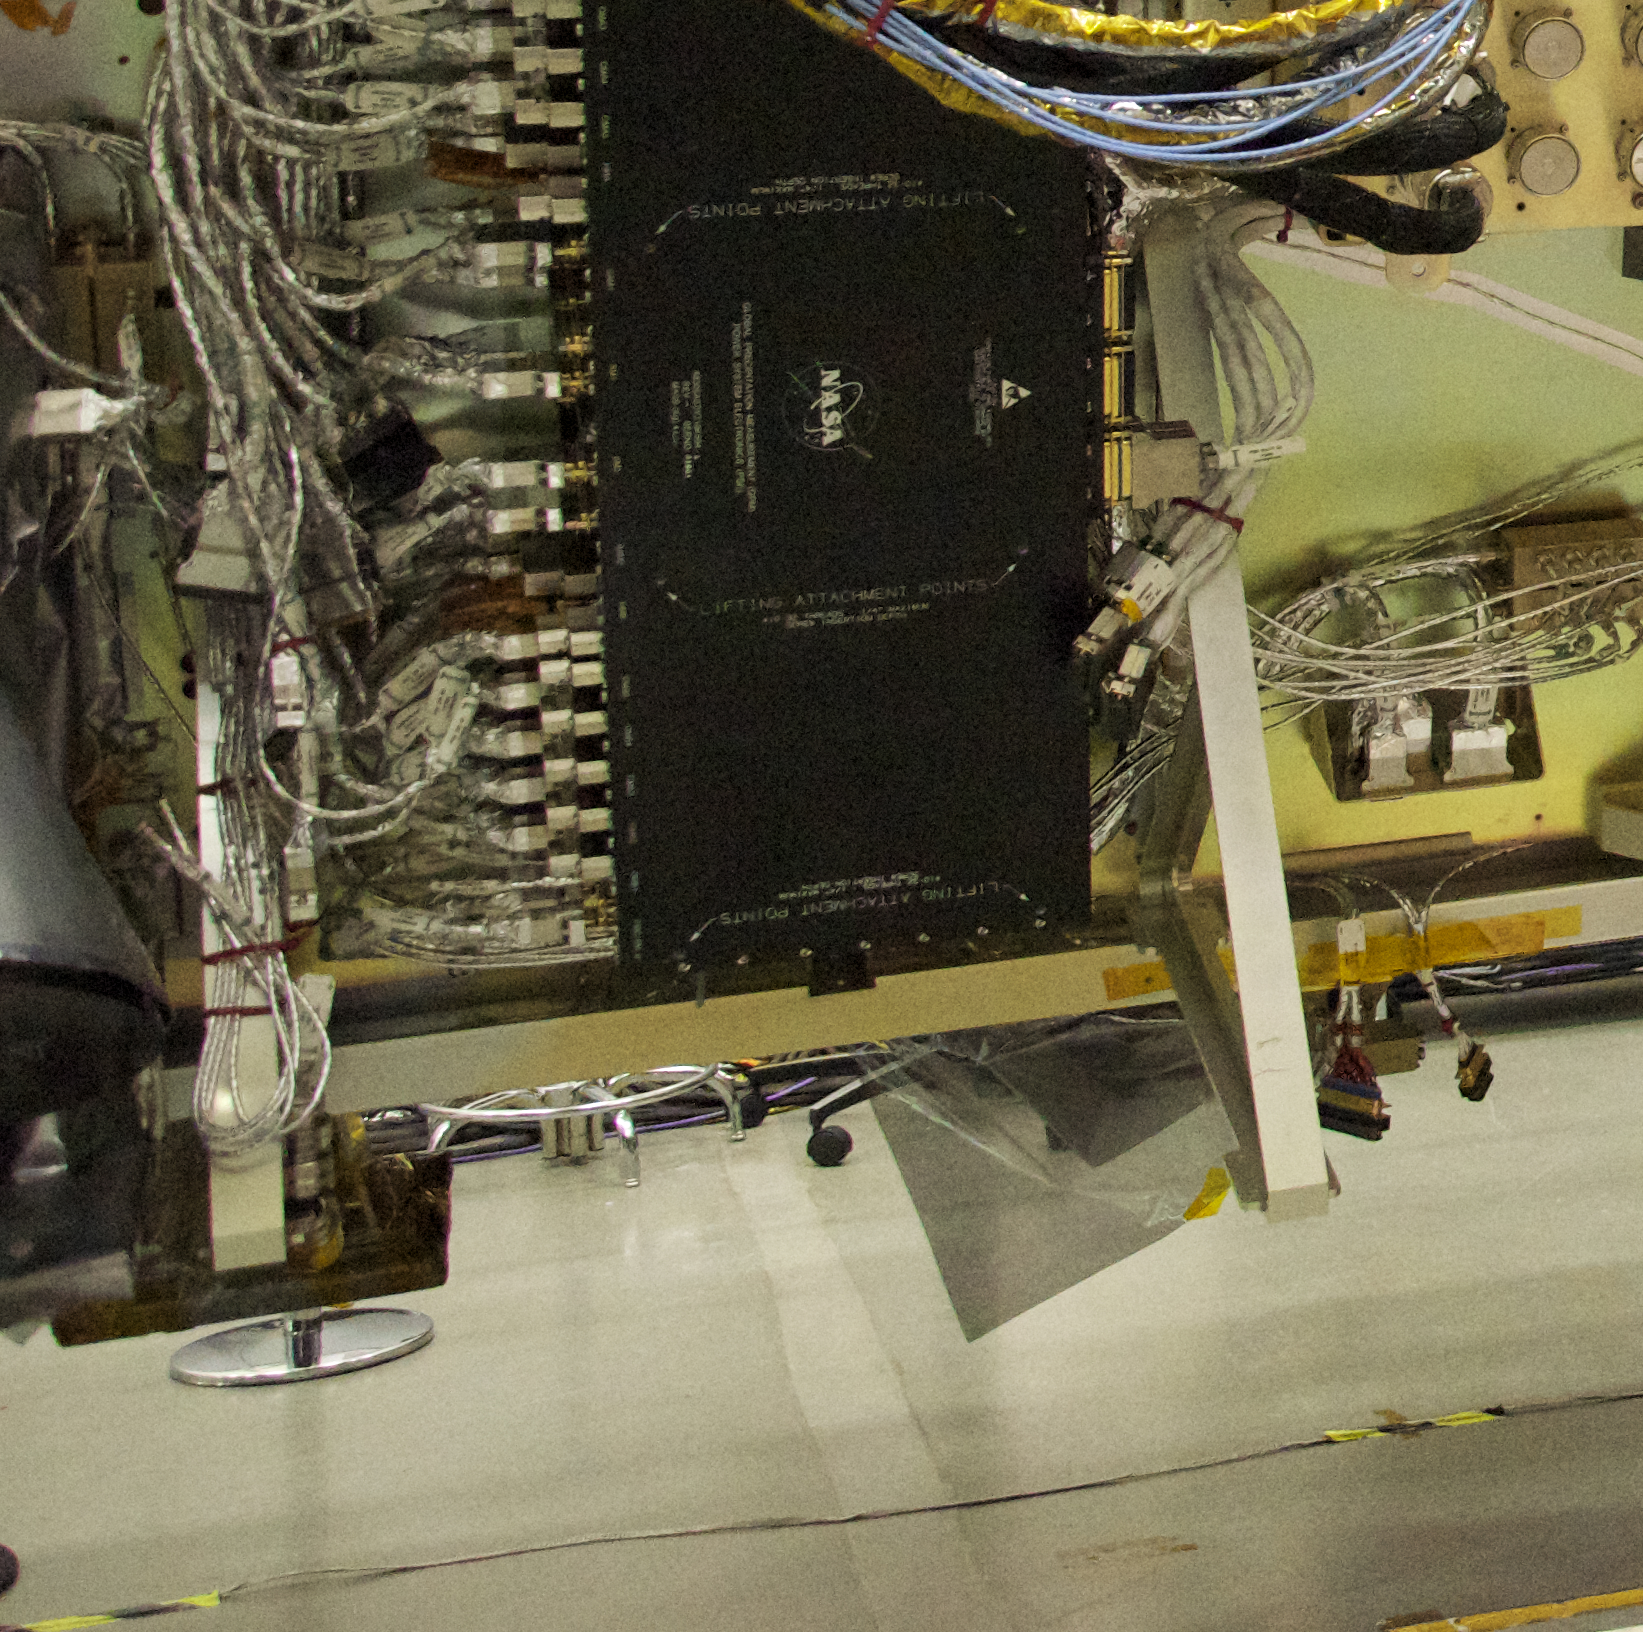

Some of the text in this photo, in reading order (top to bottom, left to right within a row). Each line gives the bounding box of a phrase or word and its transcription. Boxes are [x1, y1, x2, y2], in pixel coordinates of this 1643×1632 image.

[687, 191, 984, 219] LIFTING ATTACHMENT POINTS
[819, 368, 843, 446] NASA
[700, 578, 988, 615] LIFTING ATTACHMENT POINTS
[801, 890, 911, 916] ATTACHMENT
[921, 881, 998, 903] LIFTING
[719, 905, 789, 926] POINTS
